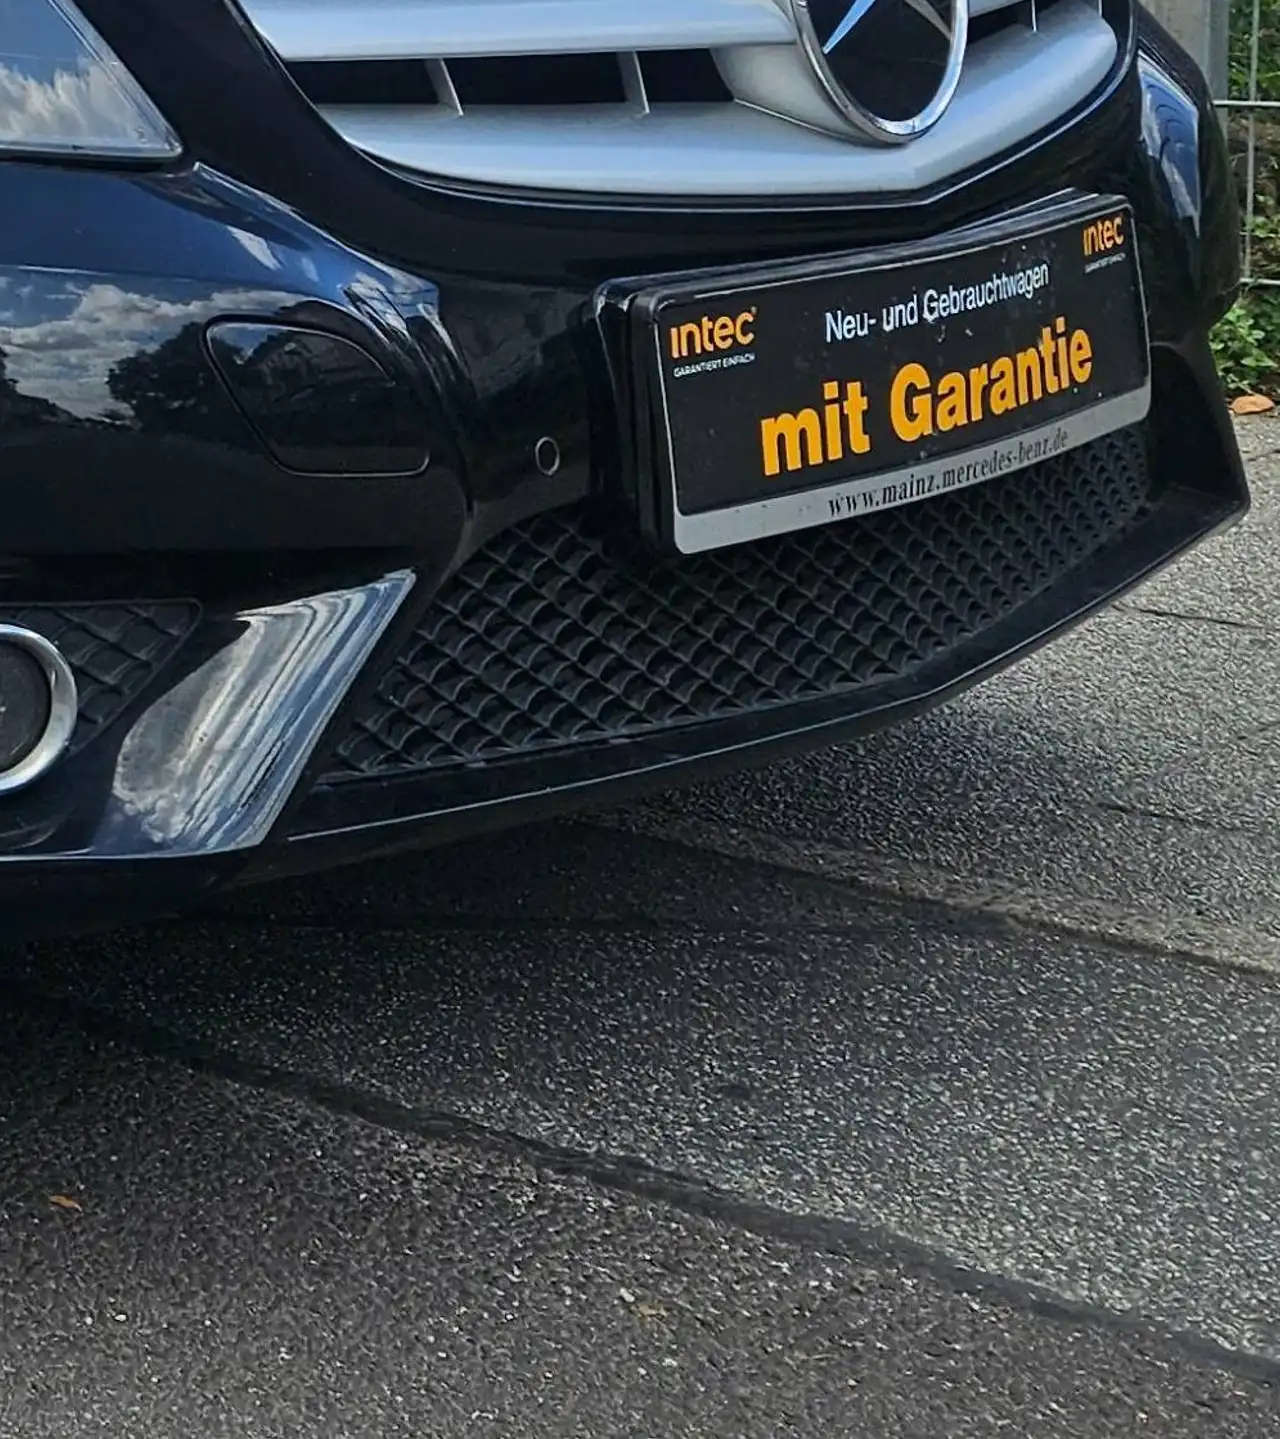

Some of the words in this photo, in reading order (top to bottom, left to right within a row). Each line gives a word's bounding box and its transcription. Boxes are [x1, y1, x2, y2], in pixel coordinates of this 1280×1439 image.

[825, 308, 876, 344] Neu-
[882, 294, 919, 332] und
[922, 261, 1050, 323] Gebrauchtwagen
[760, 379, 871, 478] mit
[888, 315, 1093, 444] Garantie
[827, 426, 1069, 518] www.mainz.mercedes-benz.de
